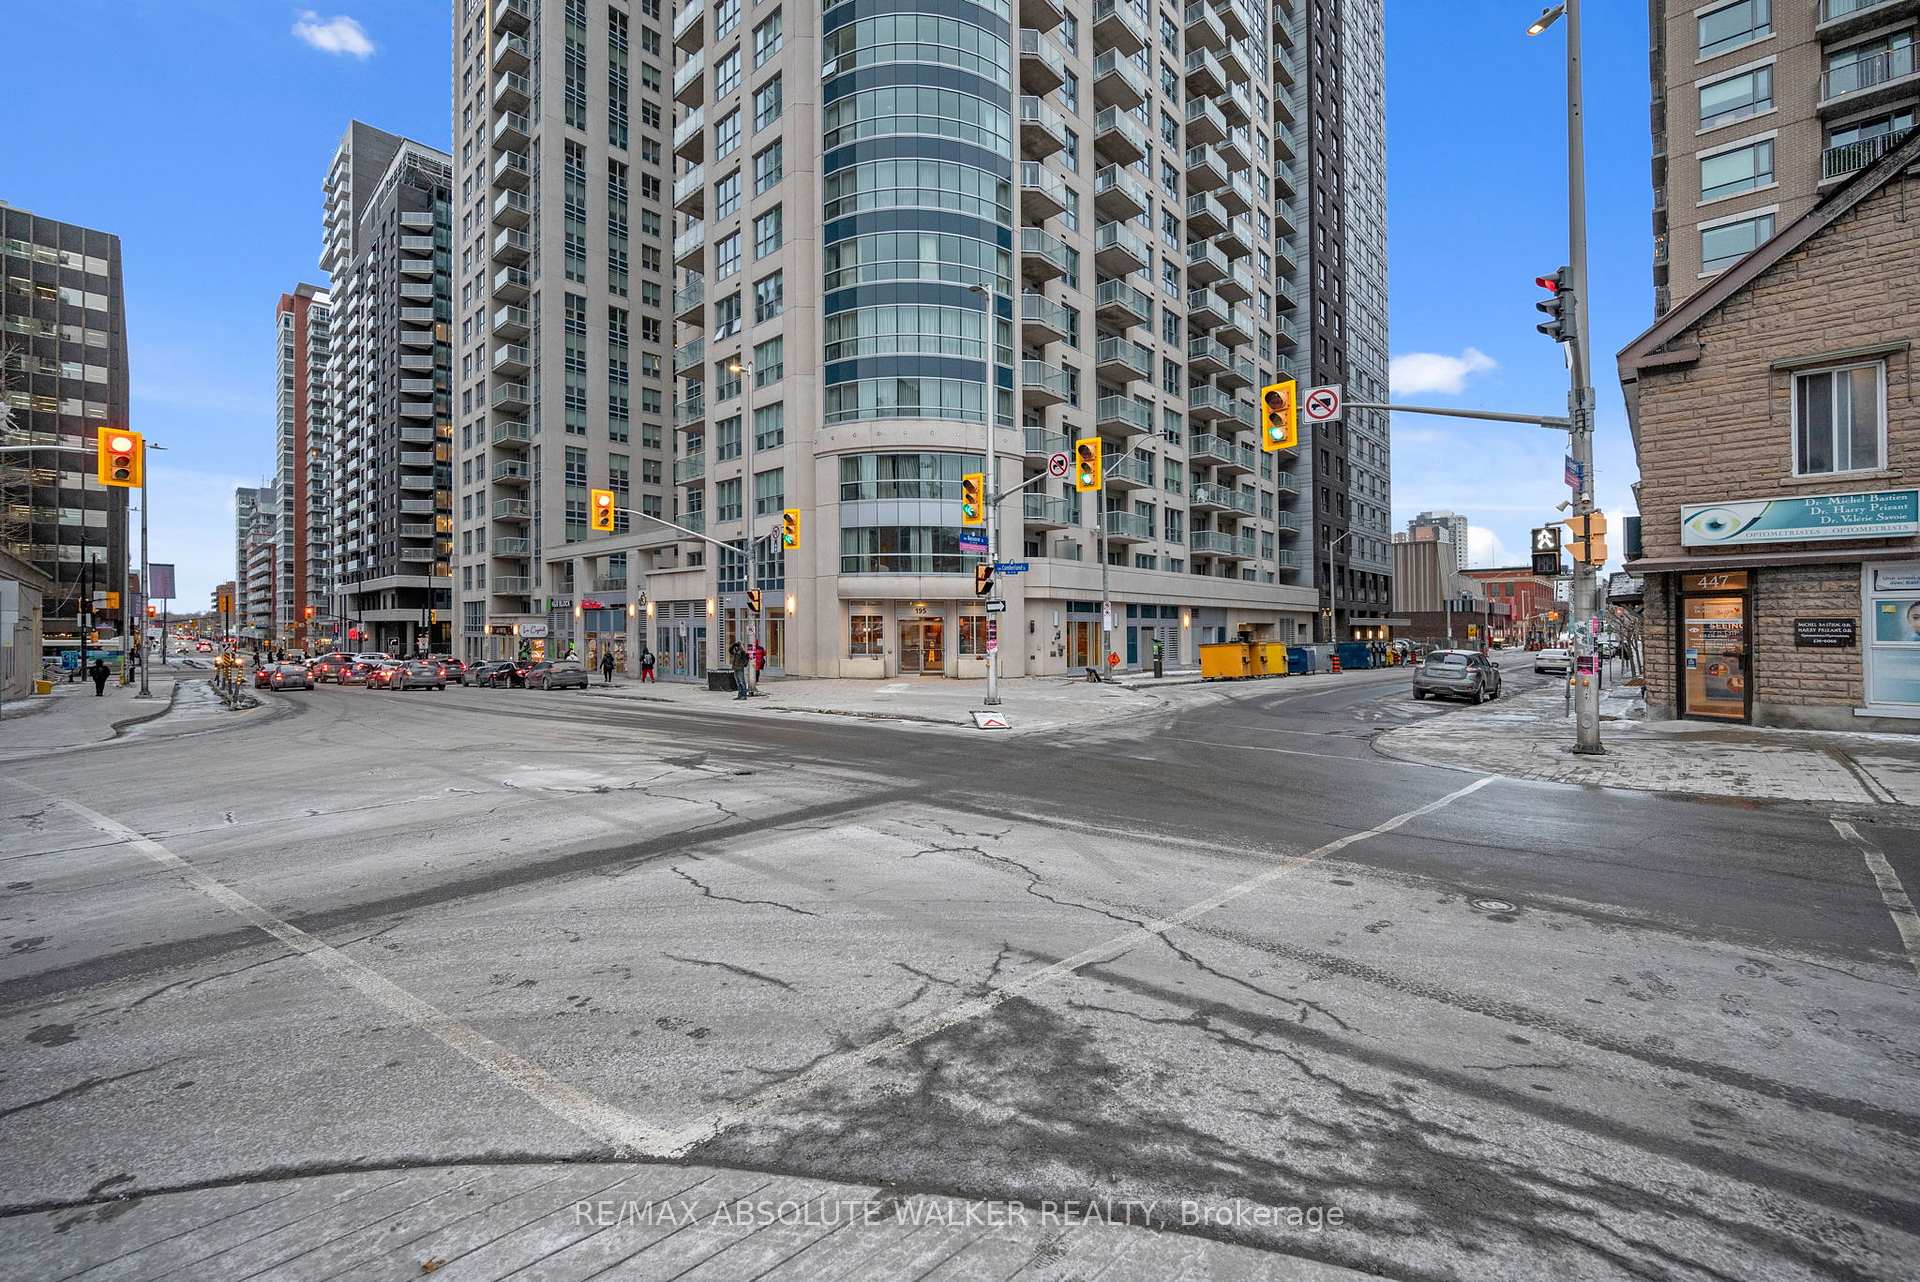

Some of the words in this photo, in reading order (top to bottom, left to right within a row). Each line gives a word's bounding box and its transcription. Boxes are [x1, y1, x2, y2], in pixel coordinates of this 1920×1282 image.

[1828, 495, 1865, 505] Michel
[1870, 494, 1908, 502] Bastien
[1811, 507, 1827, 515] Dr.
[1833, 506, 1866, 514] Harry
[1870, 503, 1908, 511] Prizant
[1819, 516, 1838, 524] Dr.
[1876, 513, 1908, 521] Savoie
[1697, 575, 1729, 589] 447
